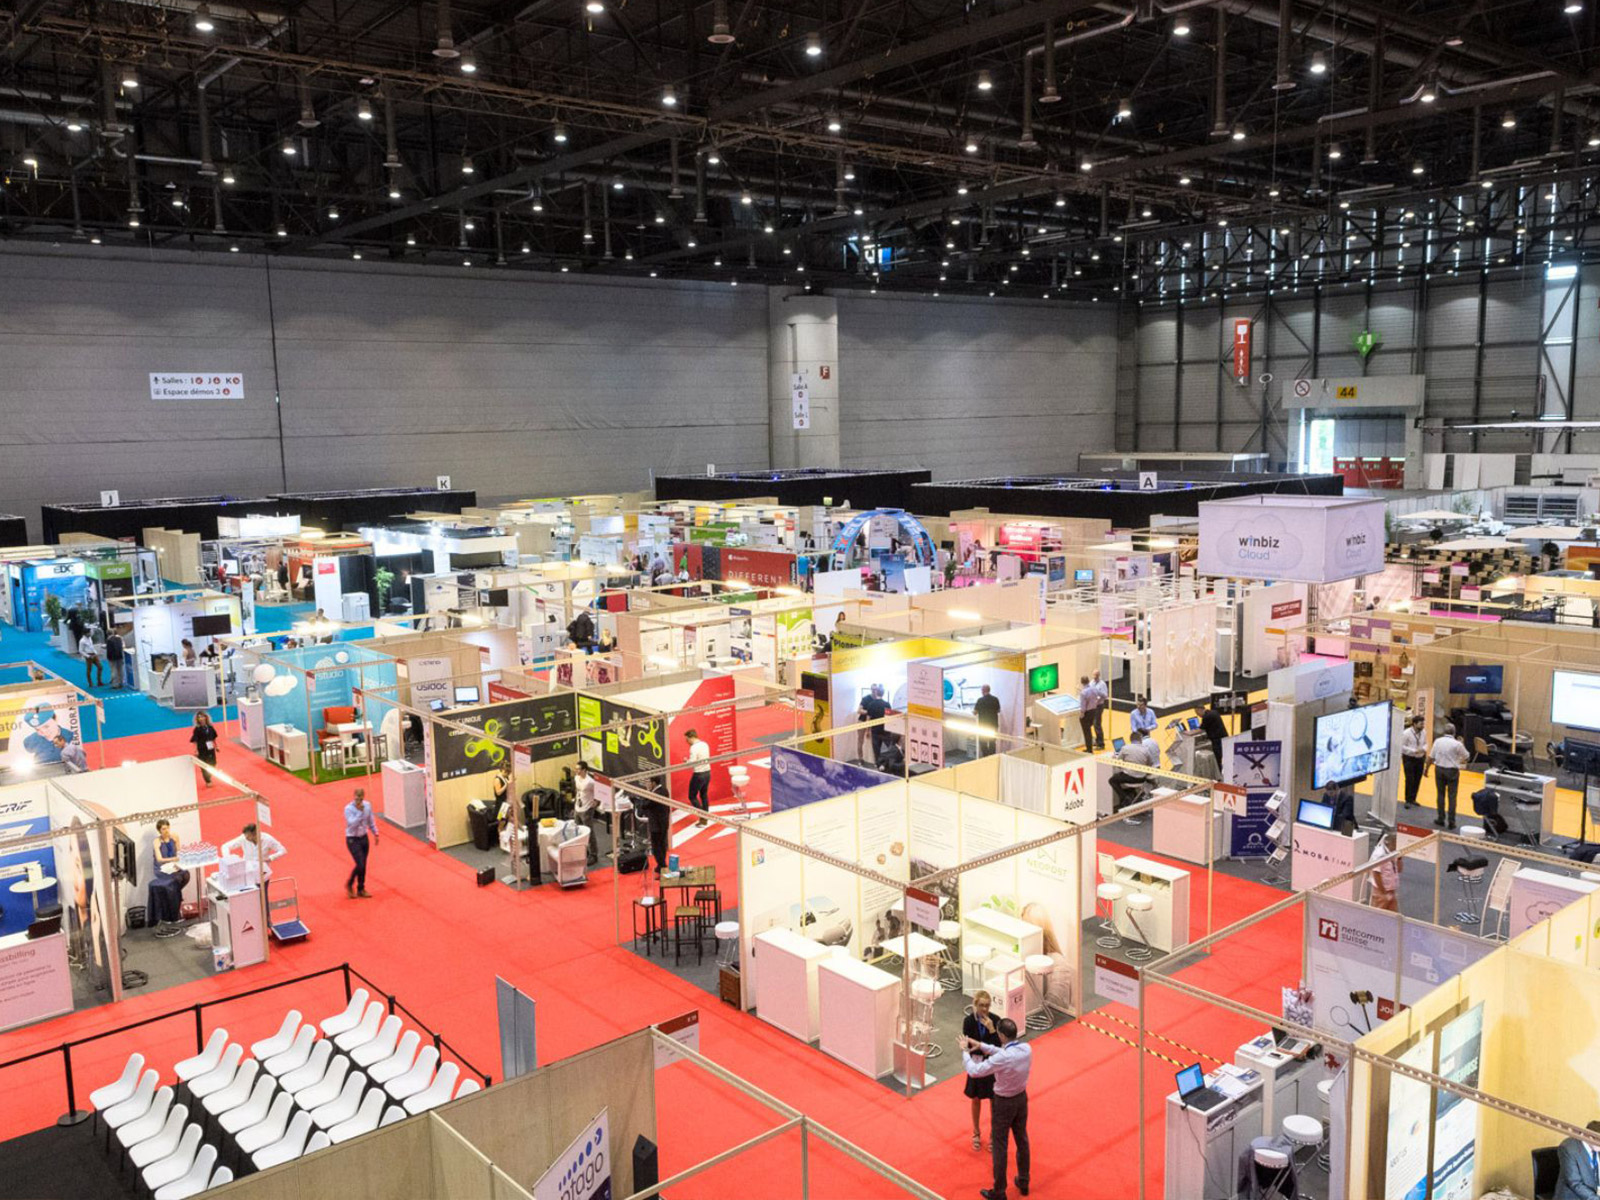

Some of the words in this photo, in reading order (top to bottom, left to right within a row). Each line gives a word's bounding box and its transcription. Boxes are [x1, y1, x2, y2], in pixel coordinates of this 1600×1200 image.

[190, 387, 214, 395] démos
[1340, 386, 1354, 397] 44
[440, 480, 449, 489] K
[1143, 476, 1154, 488] A
[107, 495, 113, 506] J
[1238, 535, 1280, 549] winbiz
[1345, 531, 1366, 547] winbiz
[1238, 548, 1270, 561] Cloud
[106, 566, 126, 575] sage
[728, 570, 783, 584] DIFFERENT
[1236, 745, 1280, 753] MOBATIME
[1064, 798, 1085, 812] Adobe
[1341, 924, 1385, 944] netcomm
[1341, 932, 1369, 947] suisse
